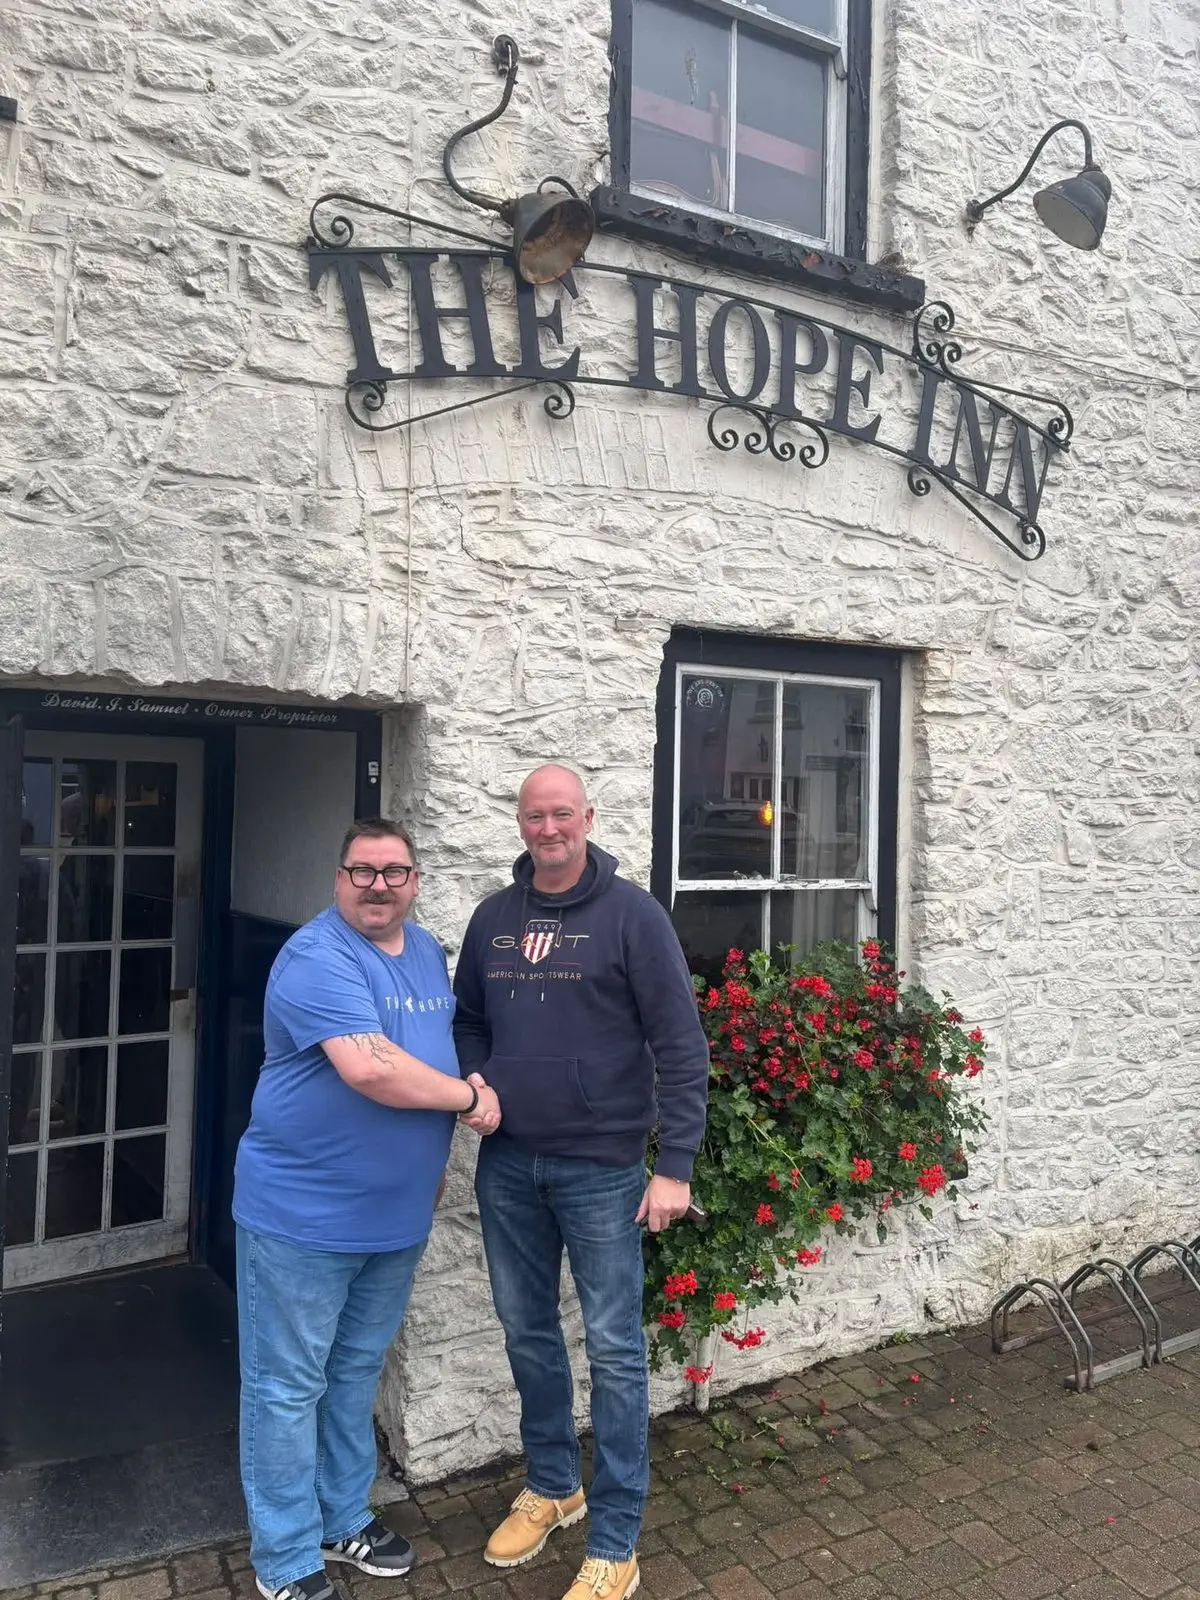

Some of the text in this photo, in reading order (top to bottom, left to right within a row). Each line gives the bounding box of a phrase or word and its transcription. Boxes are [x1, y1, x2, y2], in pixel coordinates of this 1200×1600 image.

[309, 248, 1060, 523] THE HOPE INN
[127, 698, 189, 714] Samuel
[204, 702, 254, 719] Owner
[260, 705, 340, 725] Proprietor
[528, 971, 582, 981] SPOTSWEAR
[418, 996, 450, 1013] HOPE
